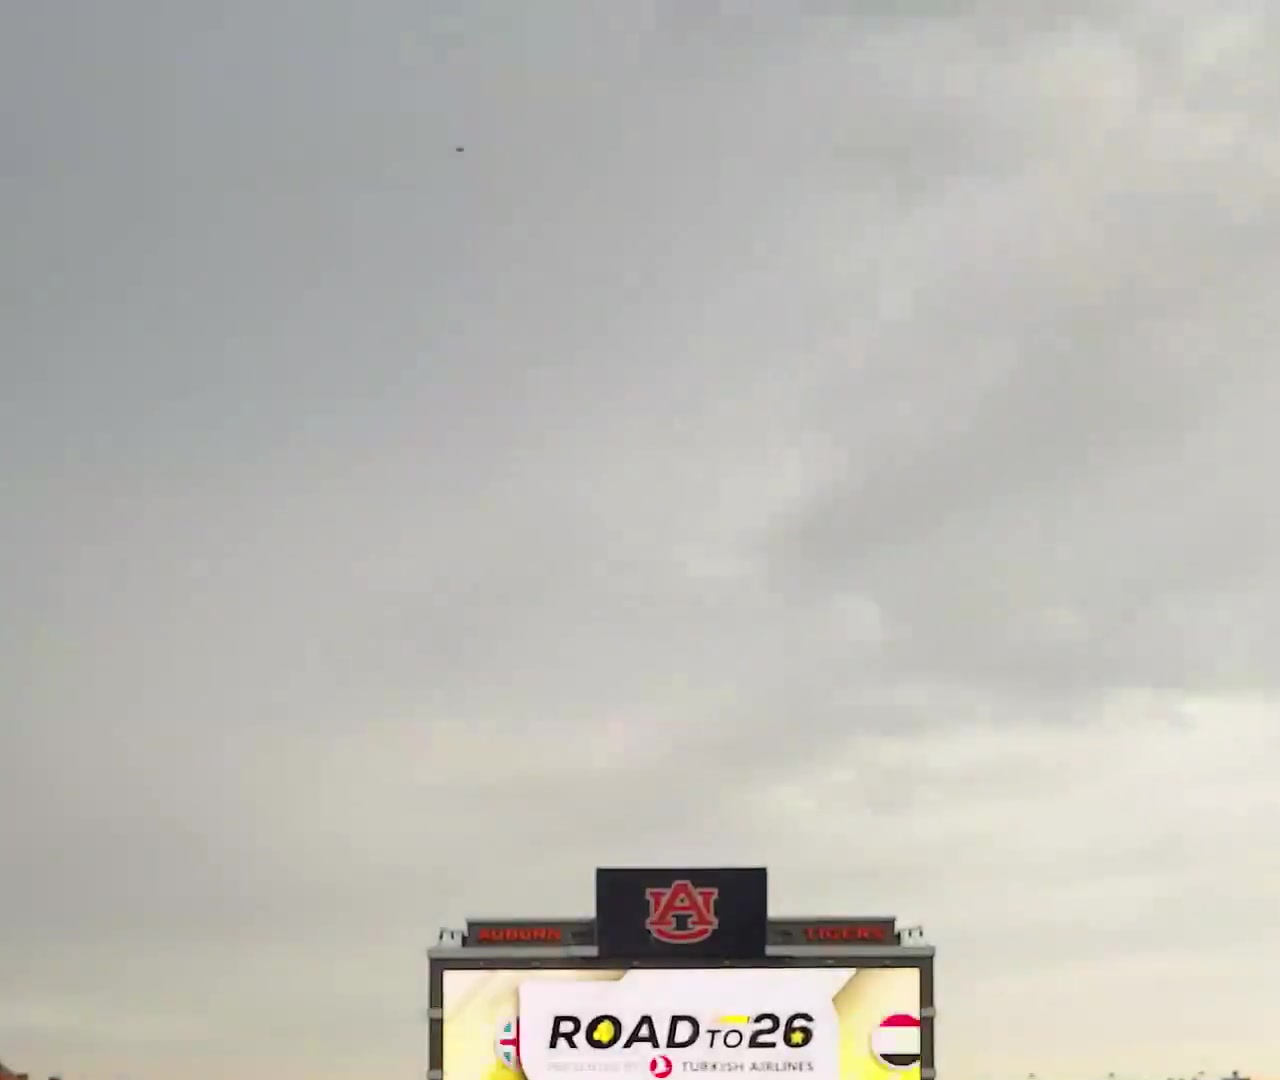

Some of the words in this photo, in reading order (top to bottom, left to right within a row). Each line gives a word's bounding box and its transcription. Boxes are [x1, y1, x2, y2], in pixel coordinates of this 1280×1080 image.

[478, 927, 561, 941] AUBURN
[803, 926, 885, 941] TIGERS
[549, 1014, 699, 1049] ROAD
[748, 1013, 815, 1049] 26
[682, 1061, 745, 1072] TURKISH
[750, 1061, 814, 1072] AIRLINES
